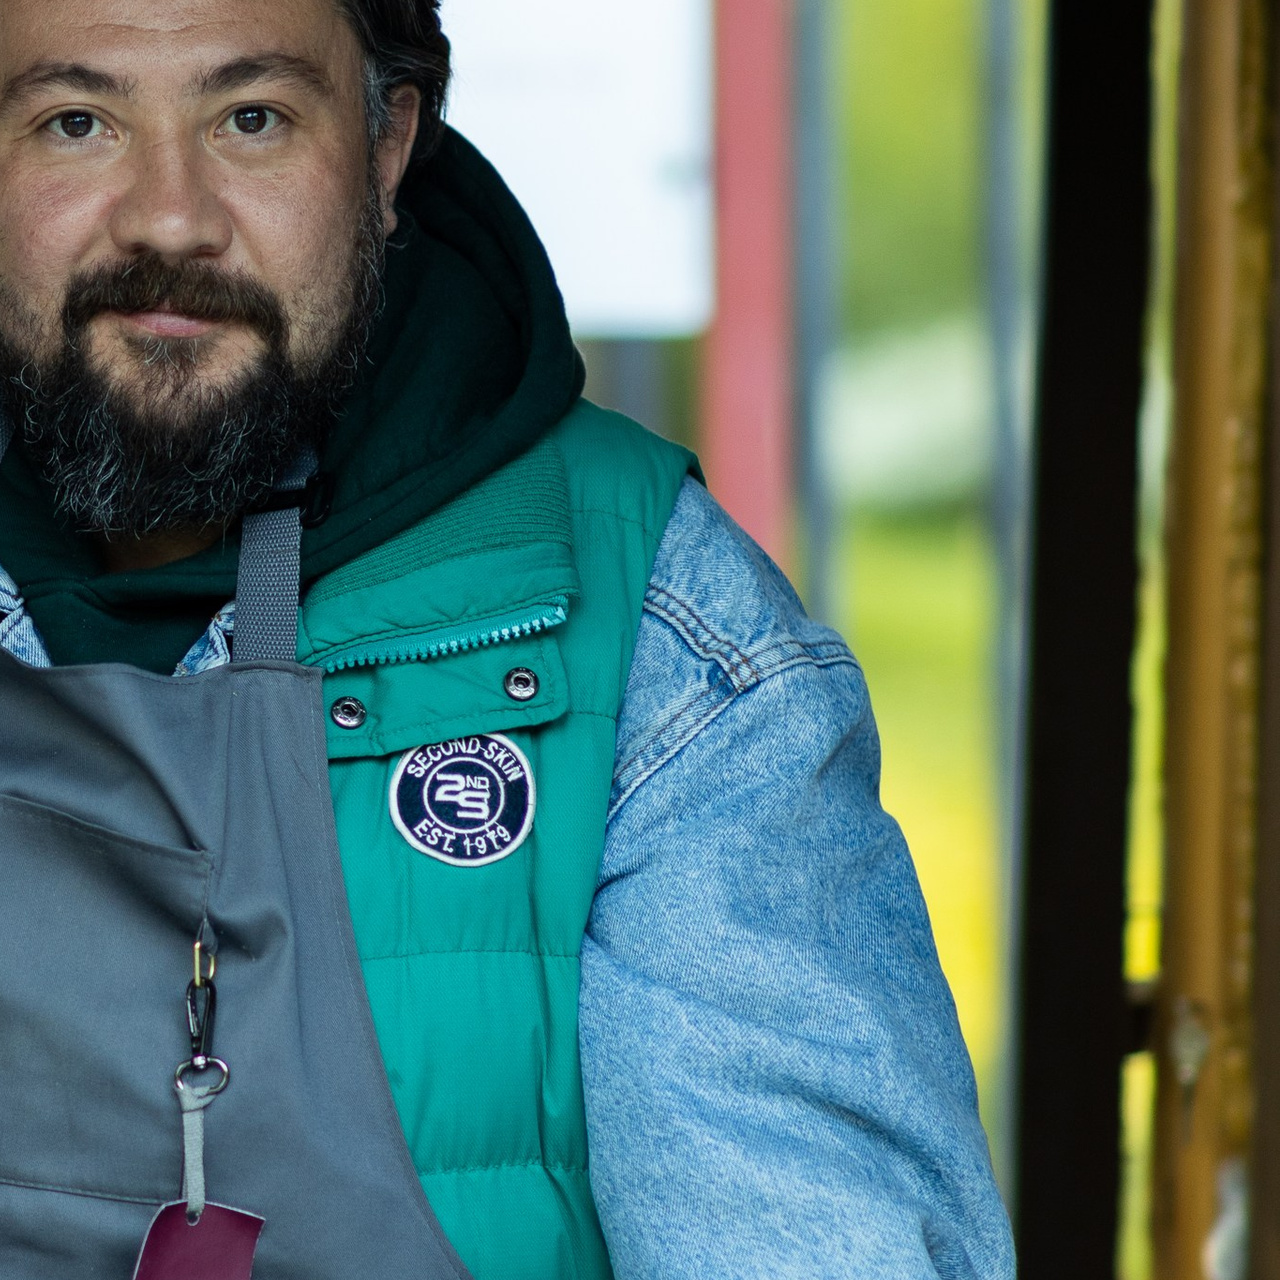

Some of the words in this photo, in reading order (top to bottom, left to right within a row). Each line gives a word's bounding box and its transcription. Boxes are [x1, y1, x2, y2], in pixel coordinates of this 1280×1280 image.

[407, 738, 480, 778] SECOND
[484, 742, 524, 782] SKIN
[463, 825, 512, 855] 1979
